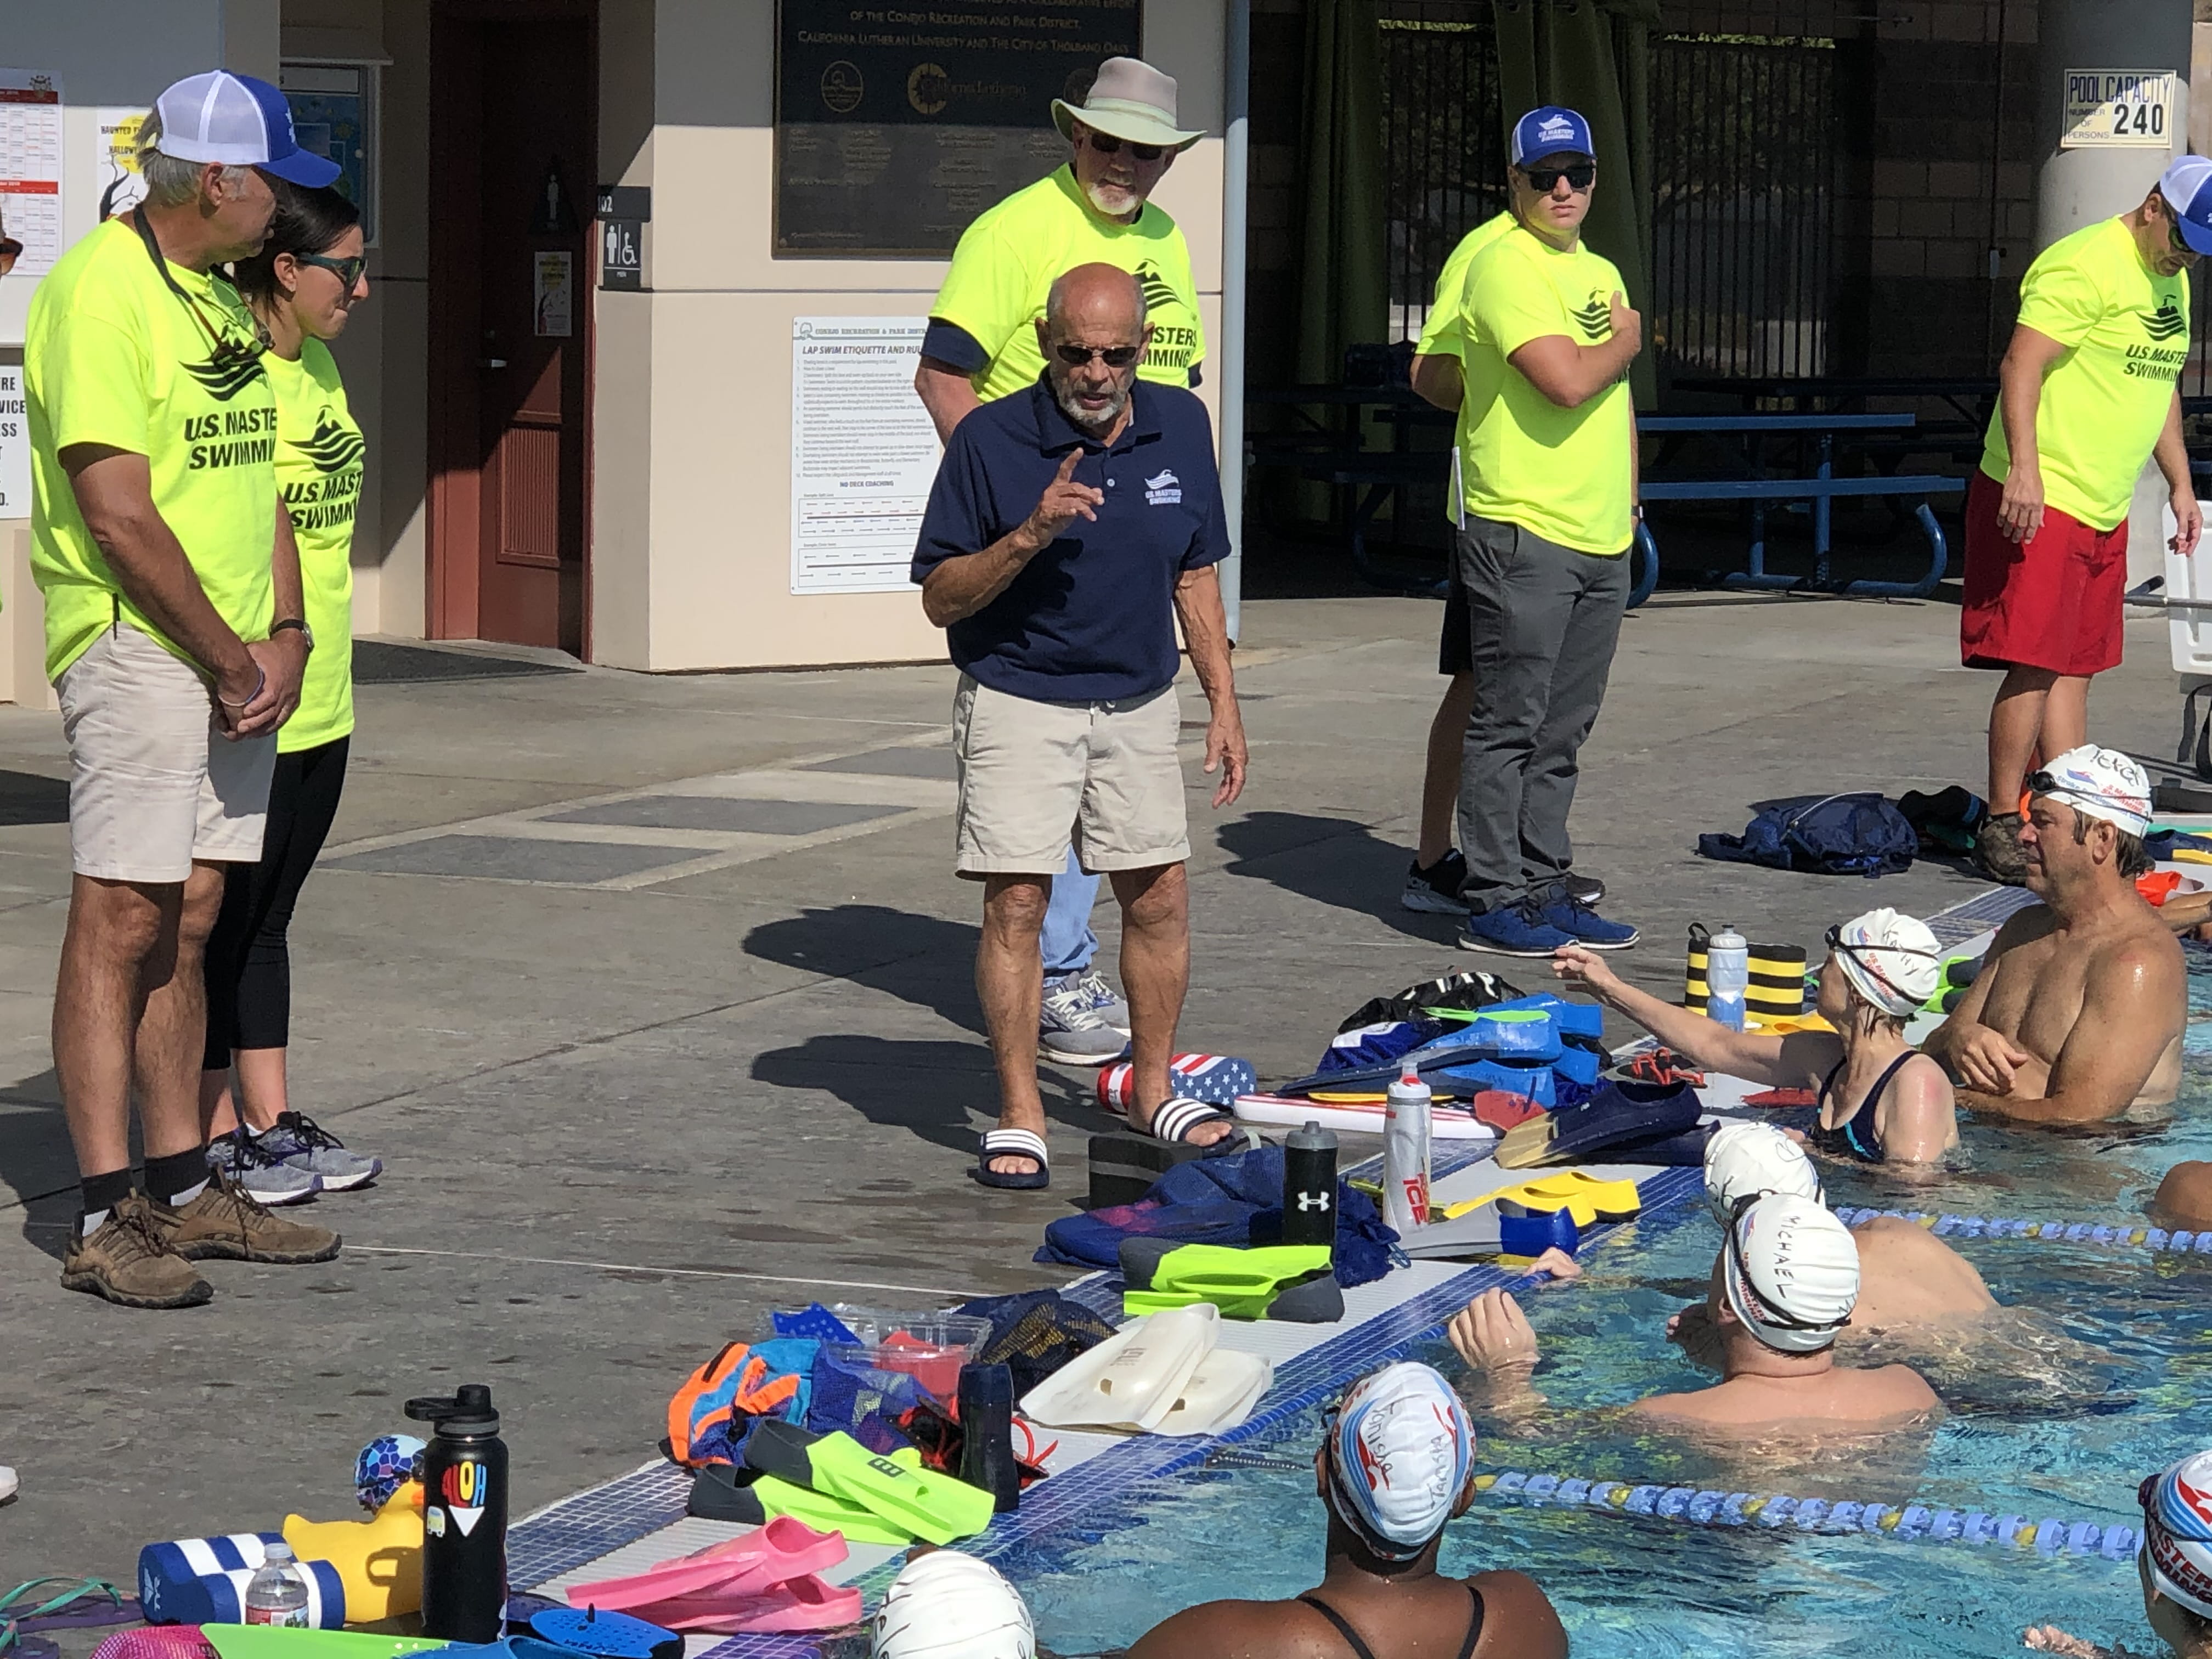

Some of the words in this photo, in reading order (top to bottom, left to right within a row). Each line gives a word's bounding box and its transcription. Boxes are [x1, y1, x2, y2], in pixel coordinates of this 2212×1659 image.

[2069, 76, 2103, 103] POOL
[2106, 76, 2171, 103] CAPACITY
[2114, 103, 2164, 135] 240
[802, 346, 818, 354] LAP
[819, 346, 842, 354] SWIM
[843, 346, 887, 355] ETIQUETTE
[887, 346, 905, 354] AND
[184, 413, 222, 442] U.S.
[283, 482, 319, 504] U.S.
[320, 471, 363, 502] MAST
[1403, 1179, 1429, 1226] ICE
[1773, 1215, 1802, 1300] MICHAEL
